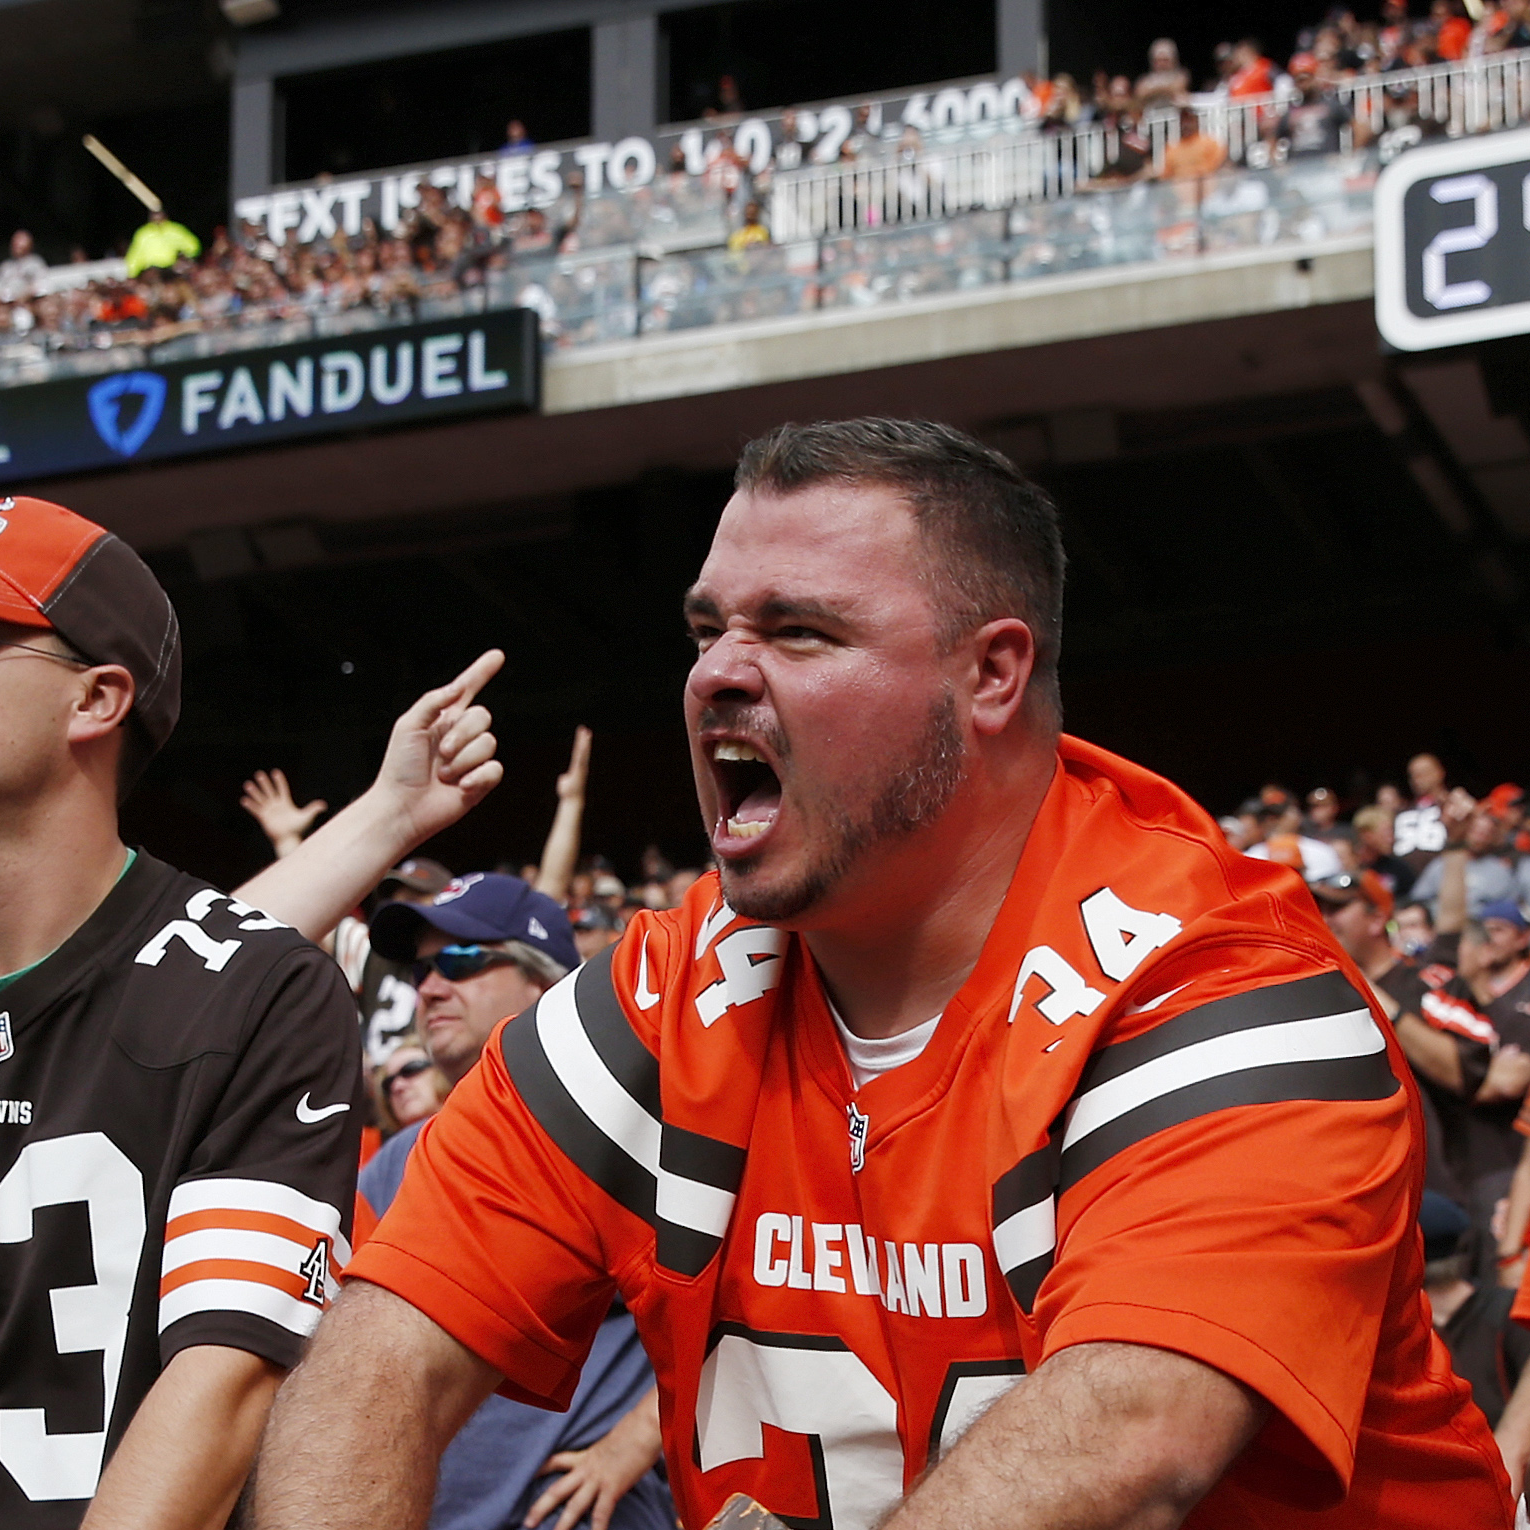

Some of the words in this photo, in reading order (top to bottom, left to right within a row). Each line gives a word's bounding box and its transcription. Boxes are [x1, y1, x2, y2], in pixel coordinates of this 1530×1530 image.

[574, 136, 657, 199] TO
[181, 329, 510, 436] FANDUEL
[753, 1211, 988, 1319] CLEVAND
